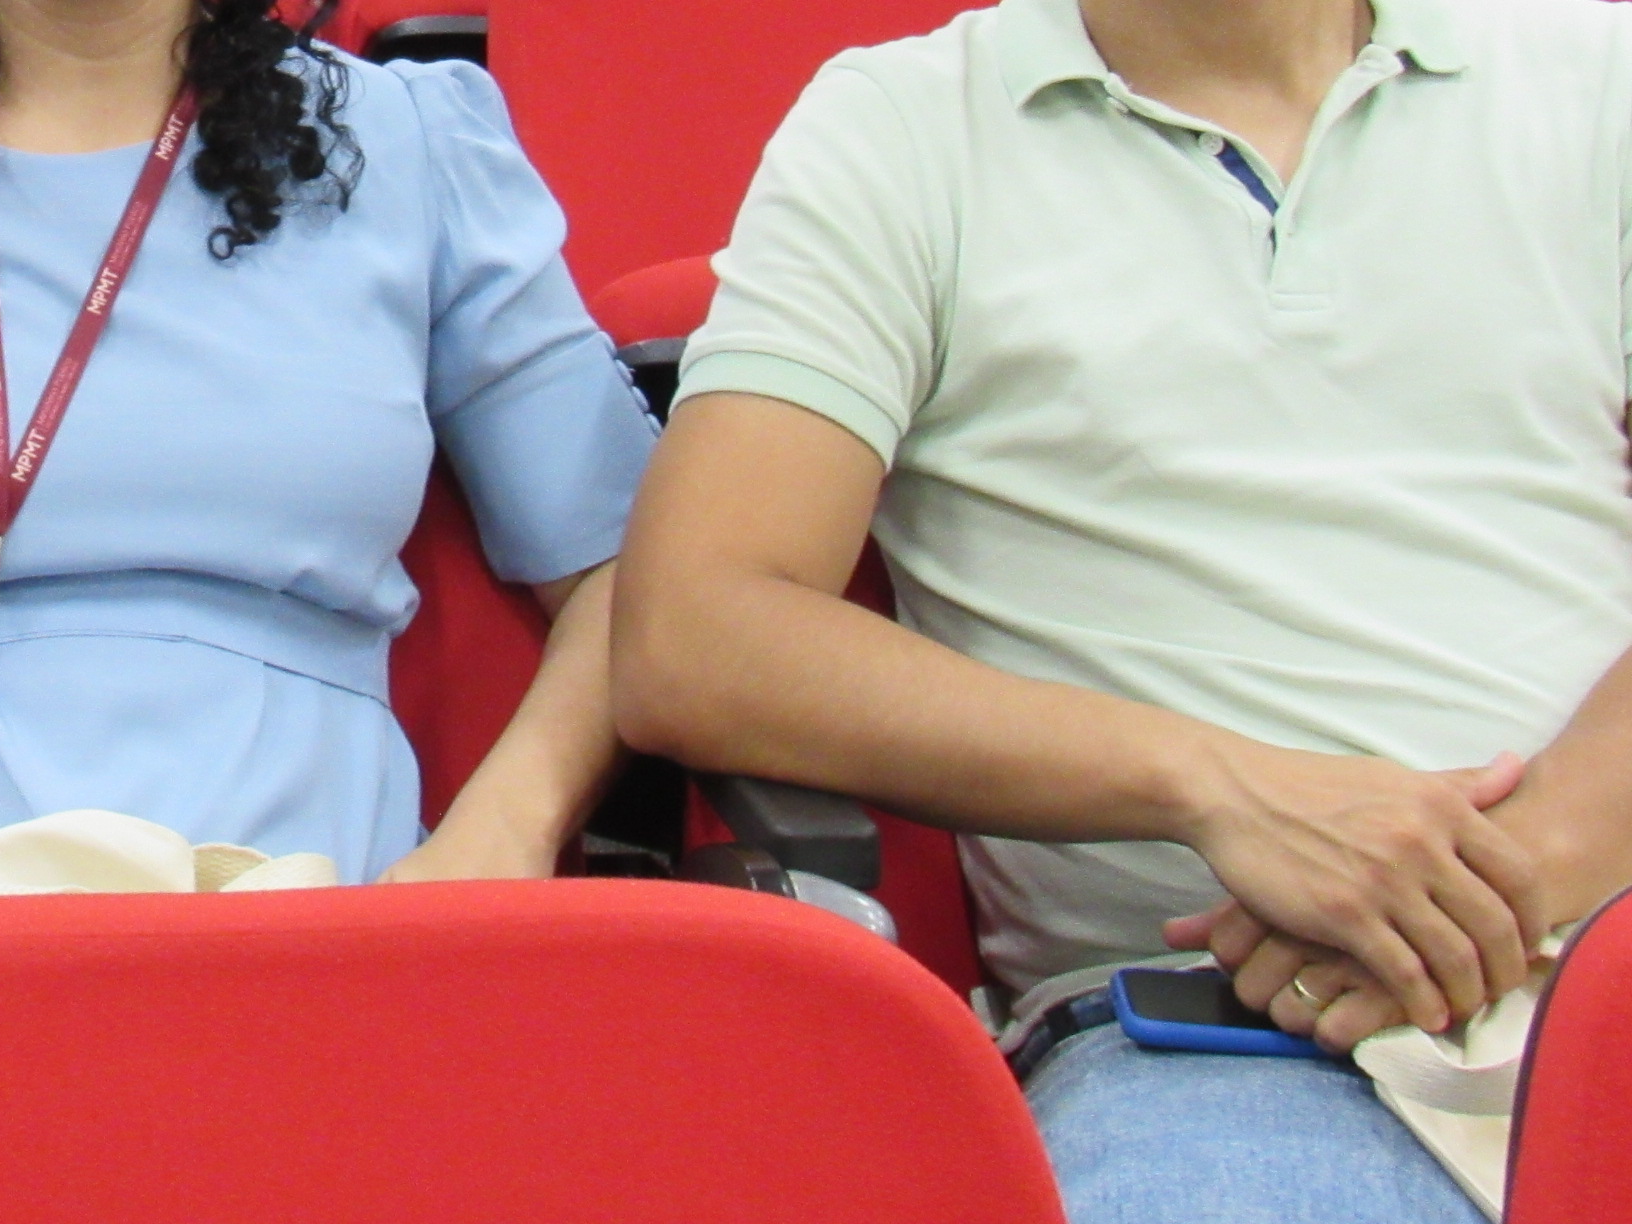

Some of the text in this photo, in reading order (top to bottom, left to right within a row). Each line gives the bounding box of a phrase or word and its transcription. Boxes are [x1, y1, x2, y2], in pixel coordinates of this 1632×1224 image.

[155, 114, 184, 160] MPMT
[86, 267, 119, 314] MPMT
[11, 428, 46, 482] MPMT
